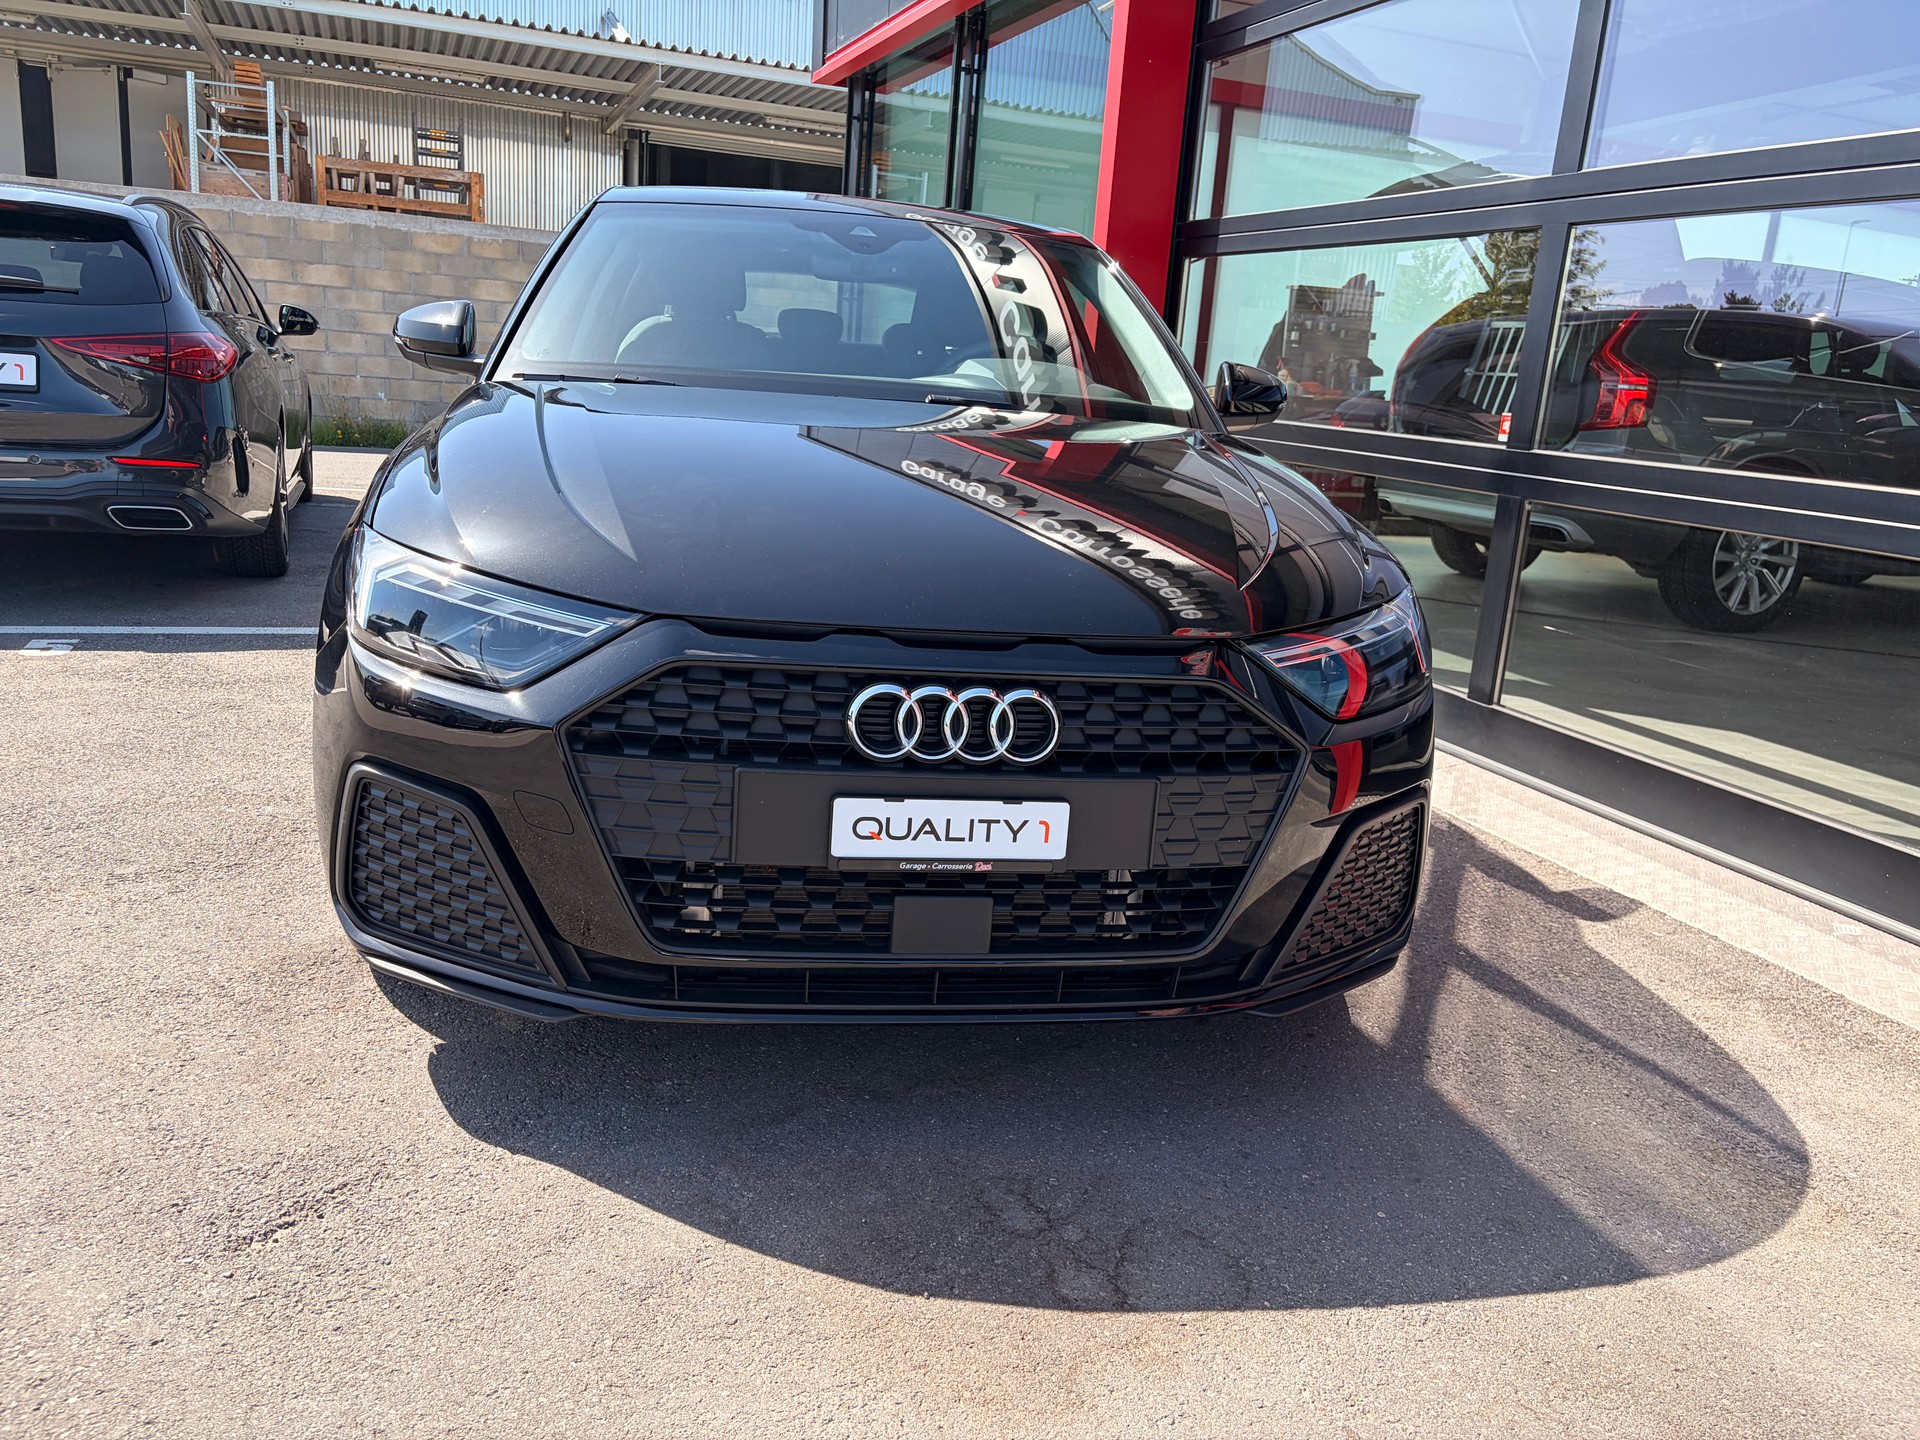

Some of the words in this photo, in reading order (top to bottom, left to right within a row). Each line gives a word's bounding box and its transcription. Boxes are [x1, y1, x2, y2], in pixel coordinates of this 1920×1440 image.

[852, 816, 1030, 843] QUALITY
[1038, 820, 1051, 843] 1
[899, 861, 927, 871] Garage
[931, 861, 973, 870] Carrosserie
